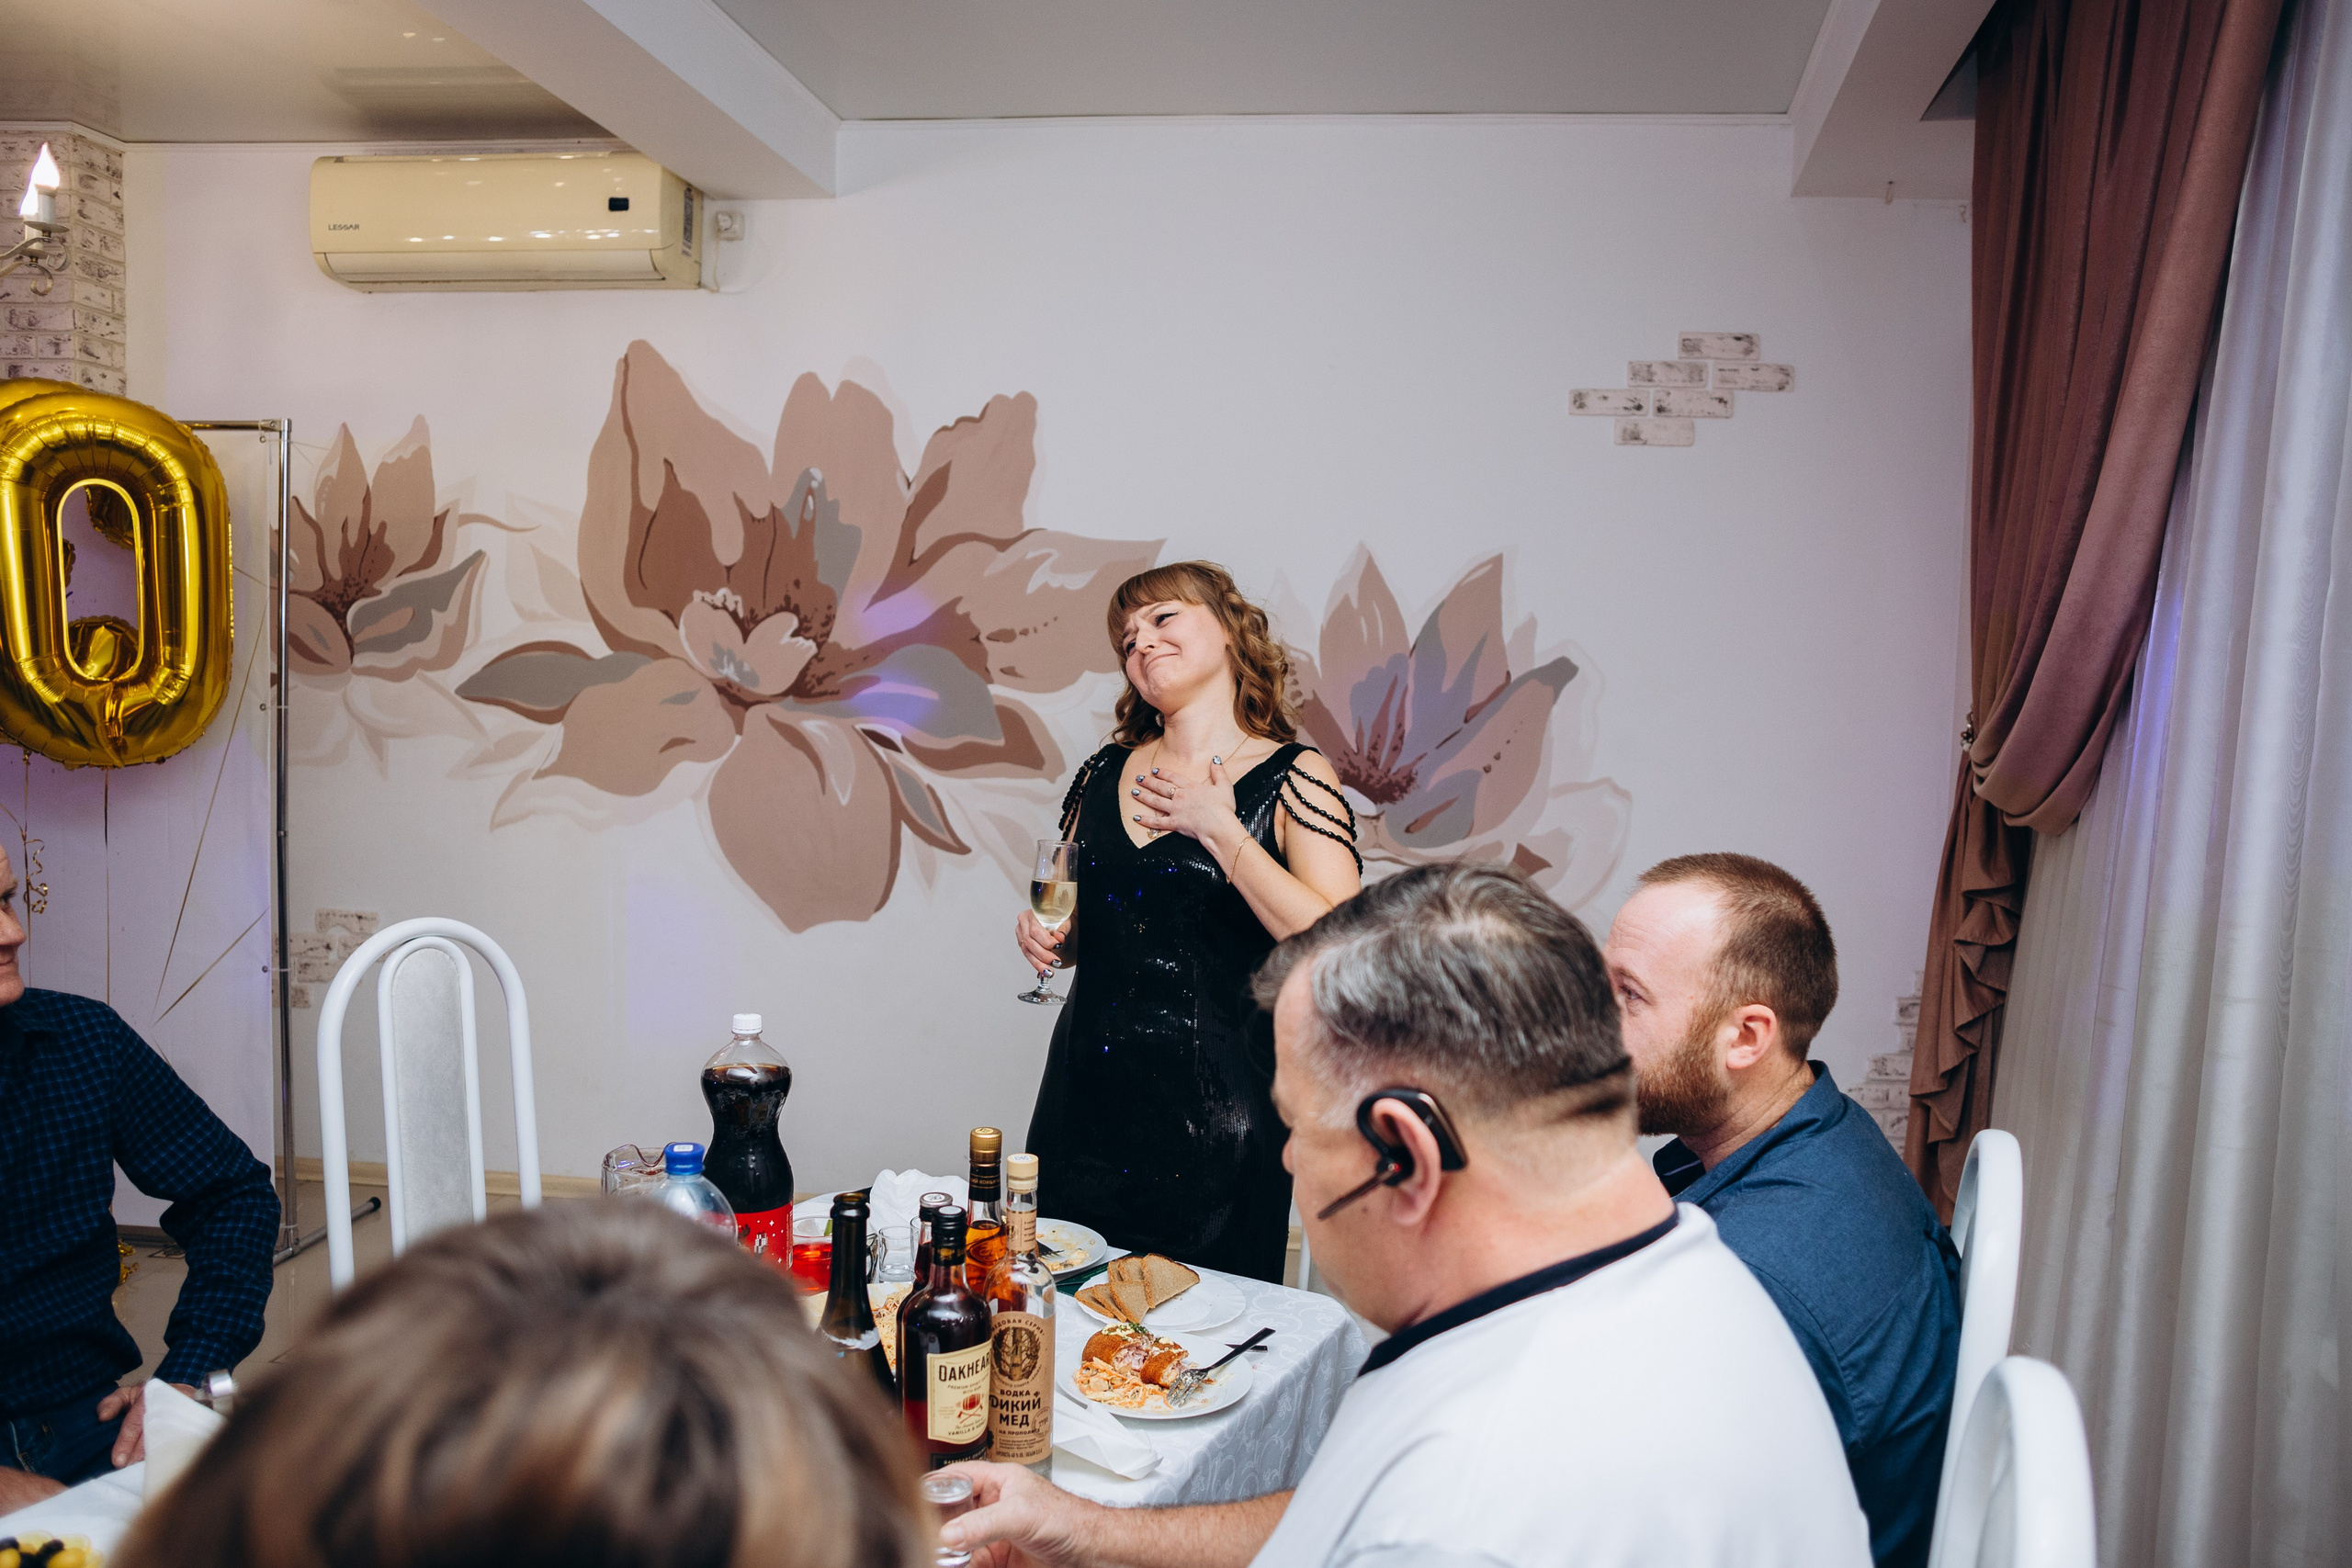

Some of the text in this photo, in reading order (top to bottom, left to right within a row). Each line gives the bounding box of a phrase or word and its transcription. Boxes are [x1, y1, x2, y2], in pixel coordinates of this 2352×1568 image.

[328, 223, 360, 231] LESSAR
[938, 1348, 991, 1382] OAKHEAR
[1000, 1389, 1030, 1397] ВОДКА
[1000, 1413, 1030, 1428] МЕД
